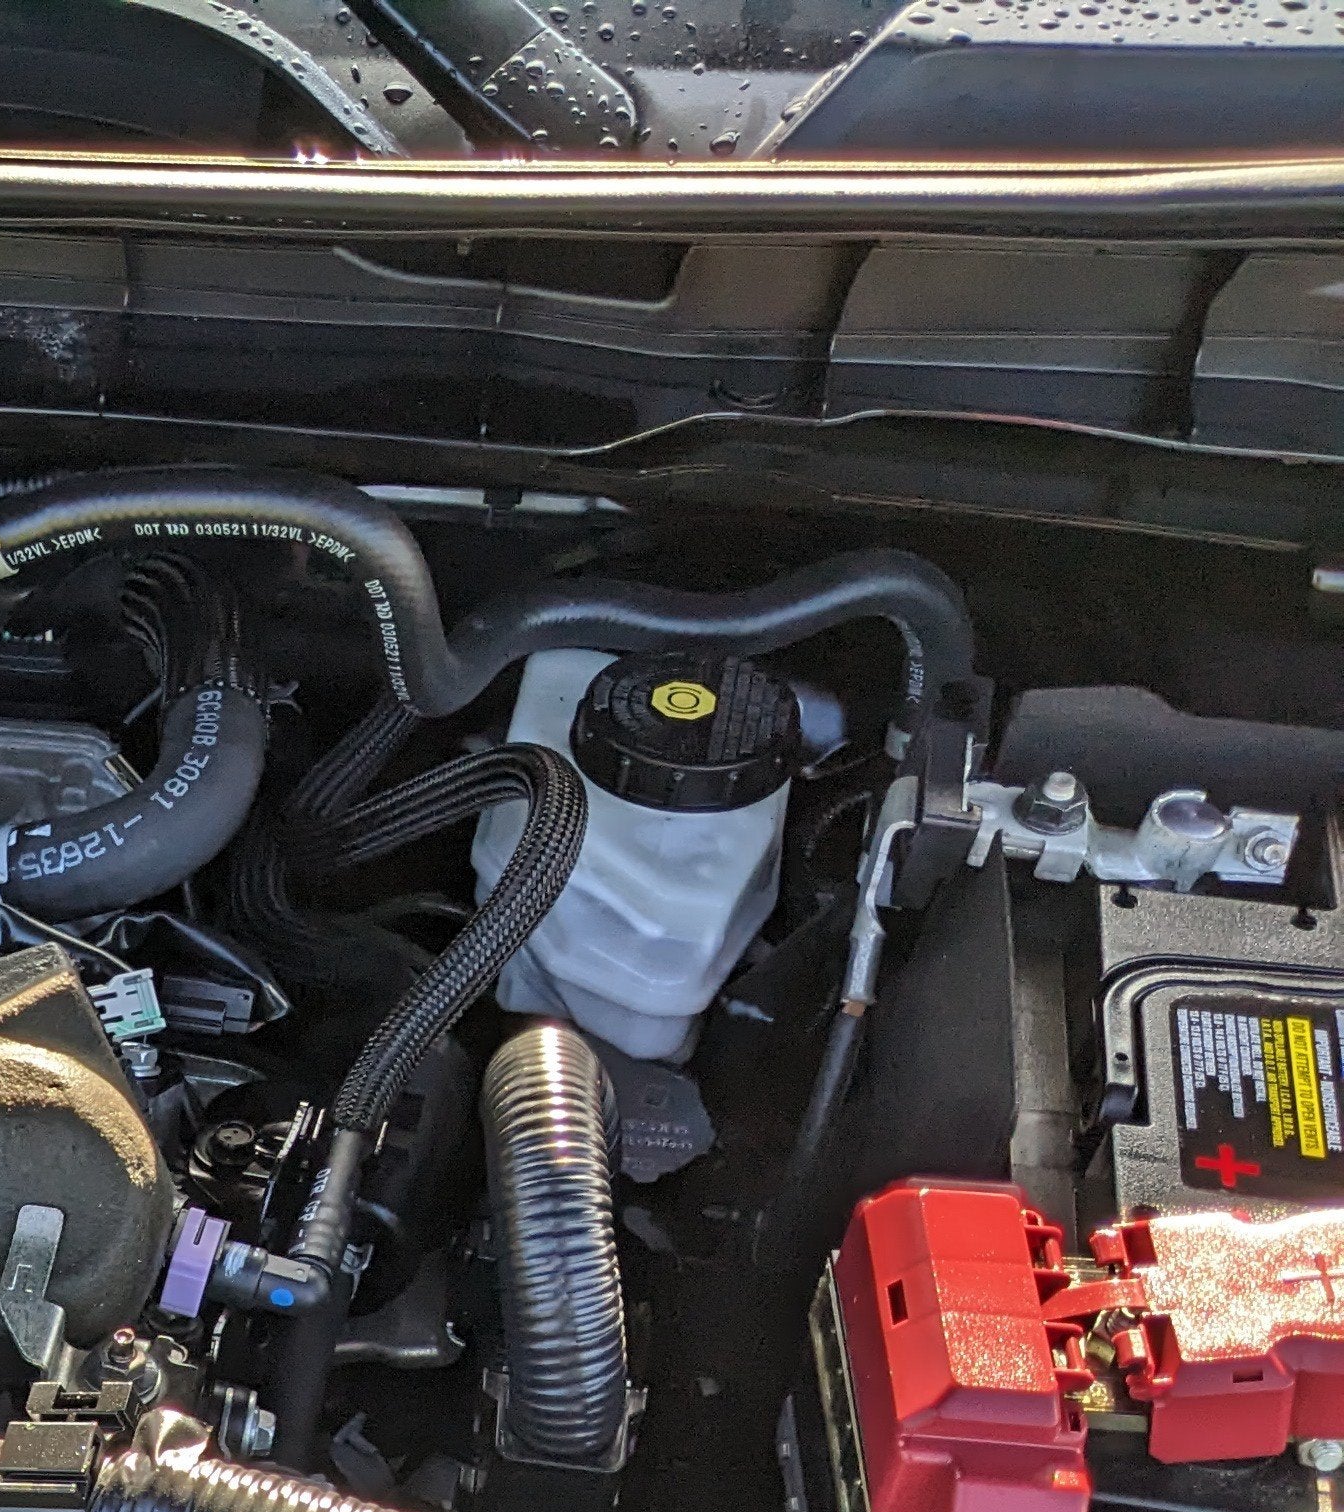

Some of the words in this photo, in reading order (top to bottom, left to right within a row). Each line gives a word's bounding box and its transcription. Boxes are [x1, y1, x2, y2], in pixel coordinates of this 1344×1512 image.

[195, 523, 248, 537] 030521
[150, 752, 210, 810] 3081
[1294, 1035, 1308, 1051] NOT
[1296, 1053, 1311, 1087] ATTEMPT
[1300, 1088, 1313, 1099] TO
[1300, 1101, 1316, 1122] OPEN
